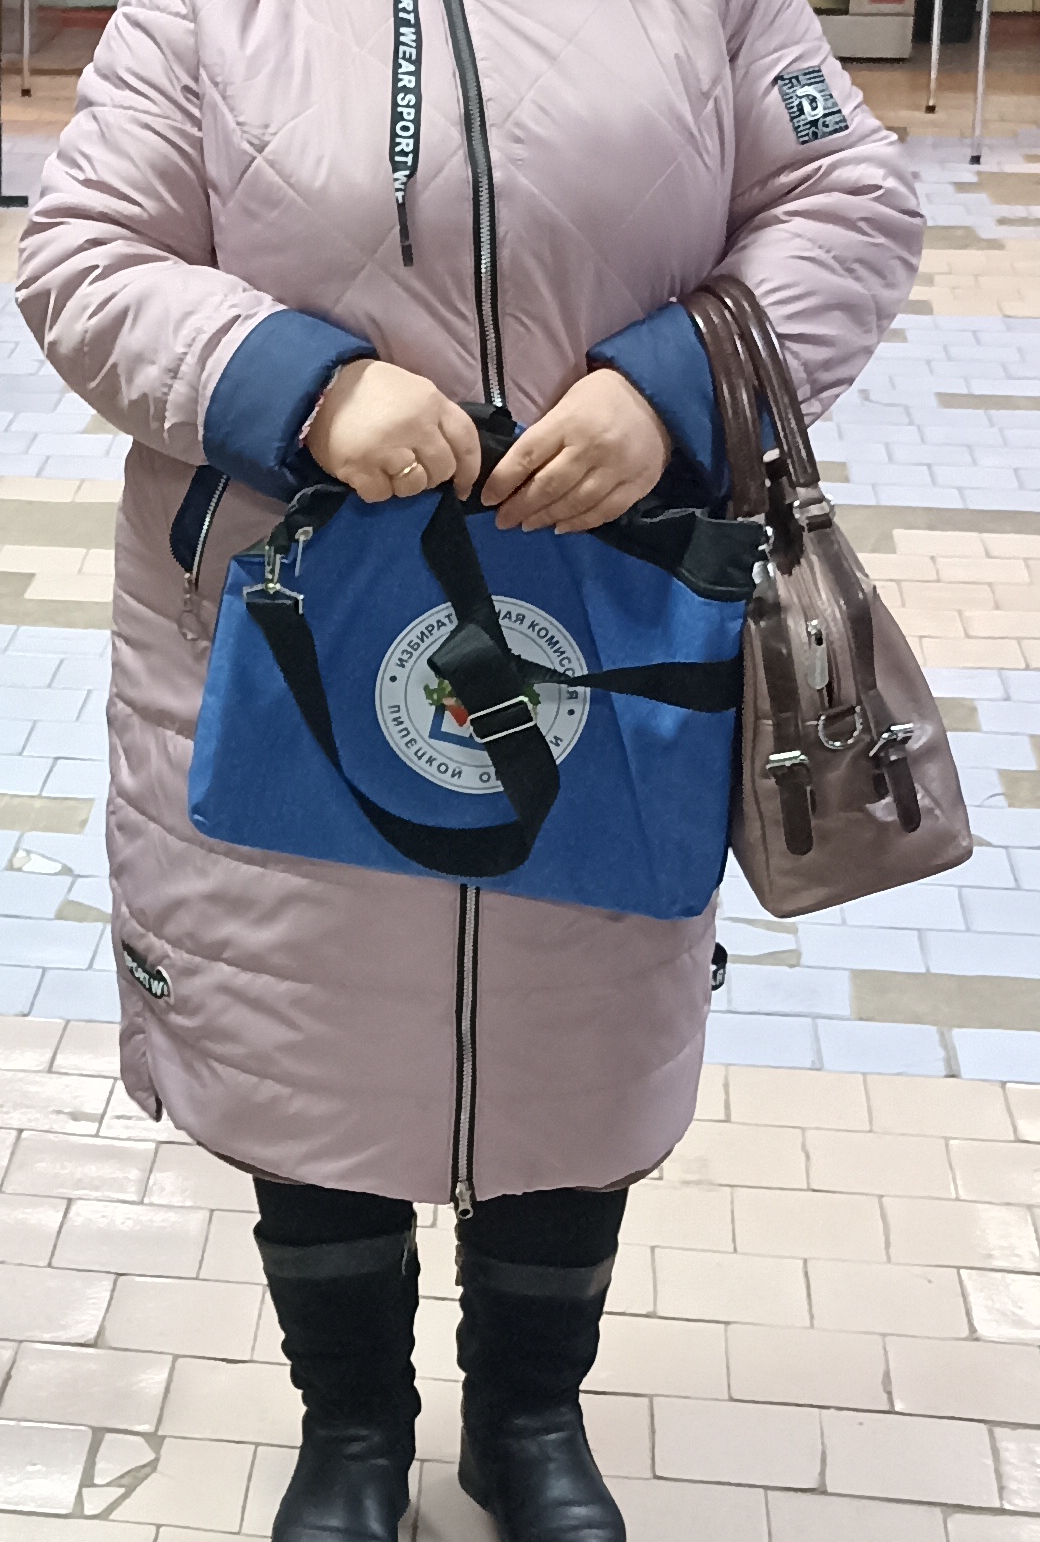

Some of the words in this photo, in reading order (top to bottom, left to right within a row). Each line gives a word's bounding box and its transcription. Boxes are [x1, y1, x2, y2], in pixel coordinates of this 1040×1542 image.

[398, 26, 417, 88] WEAR
[395, 92, 416, 167] SPORT
[396, 608, 526, 669] ИЗБИРАТАЯ
